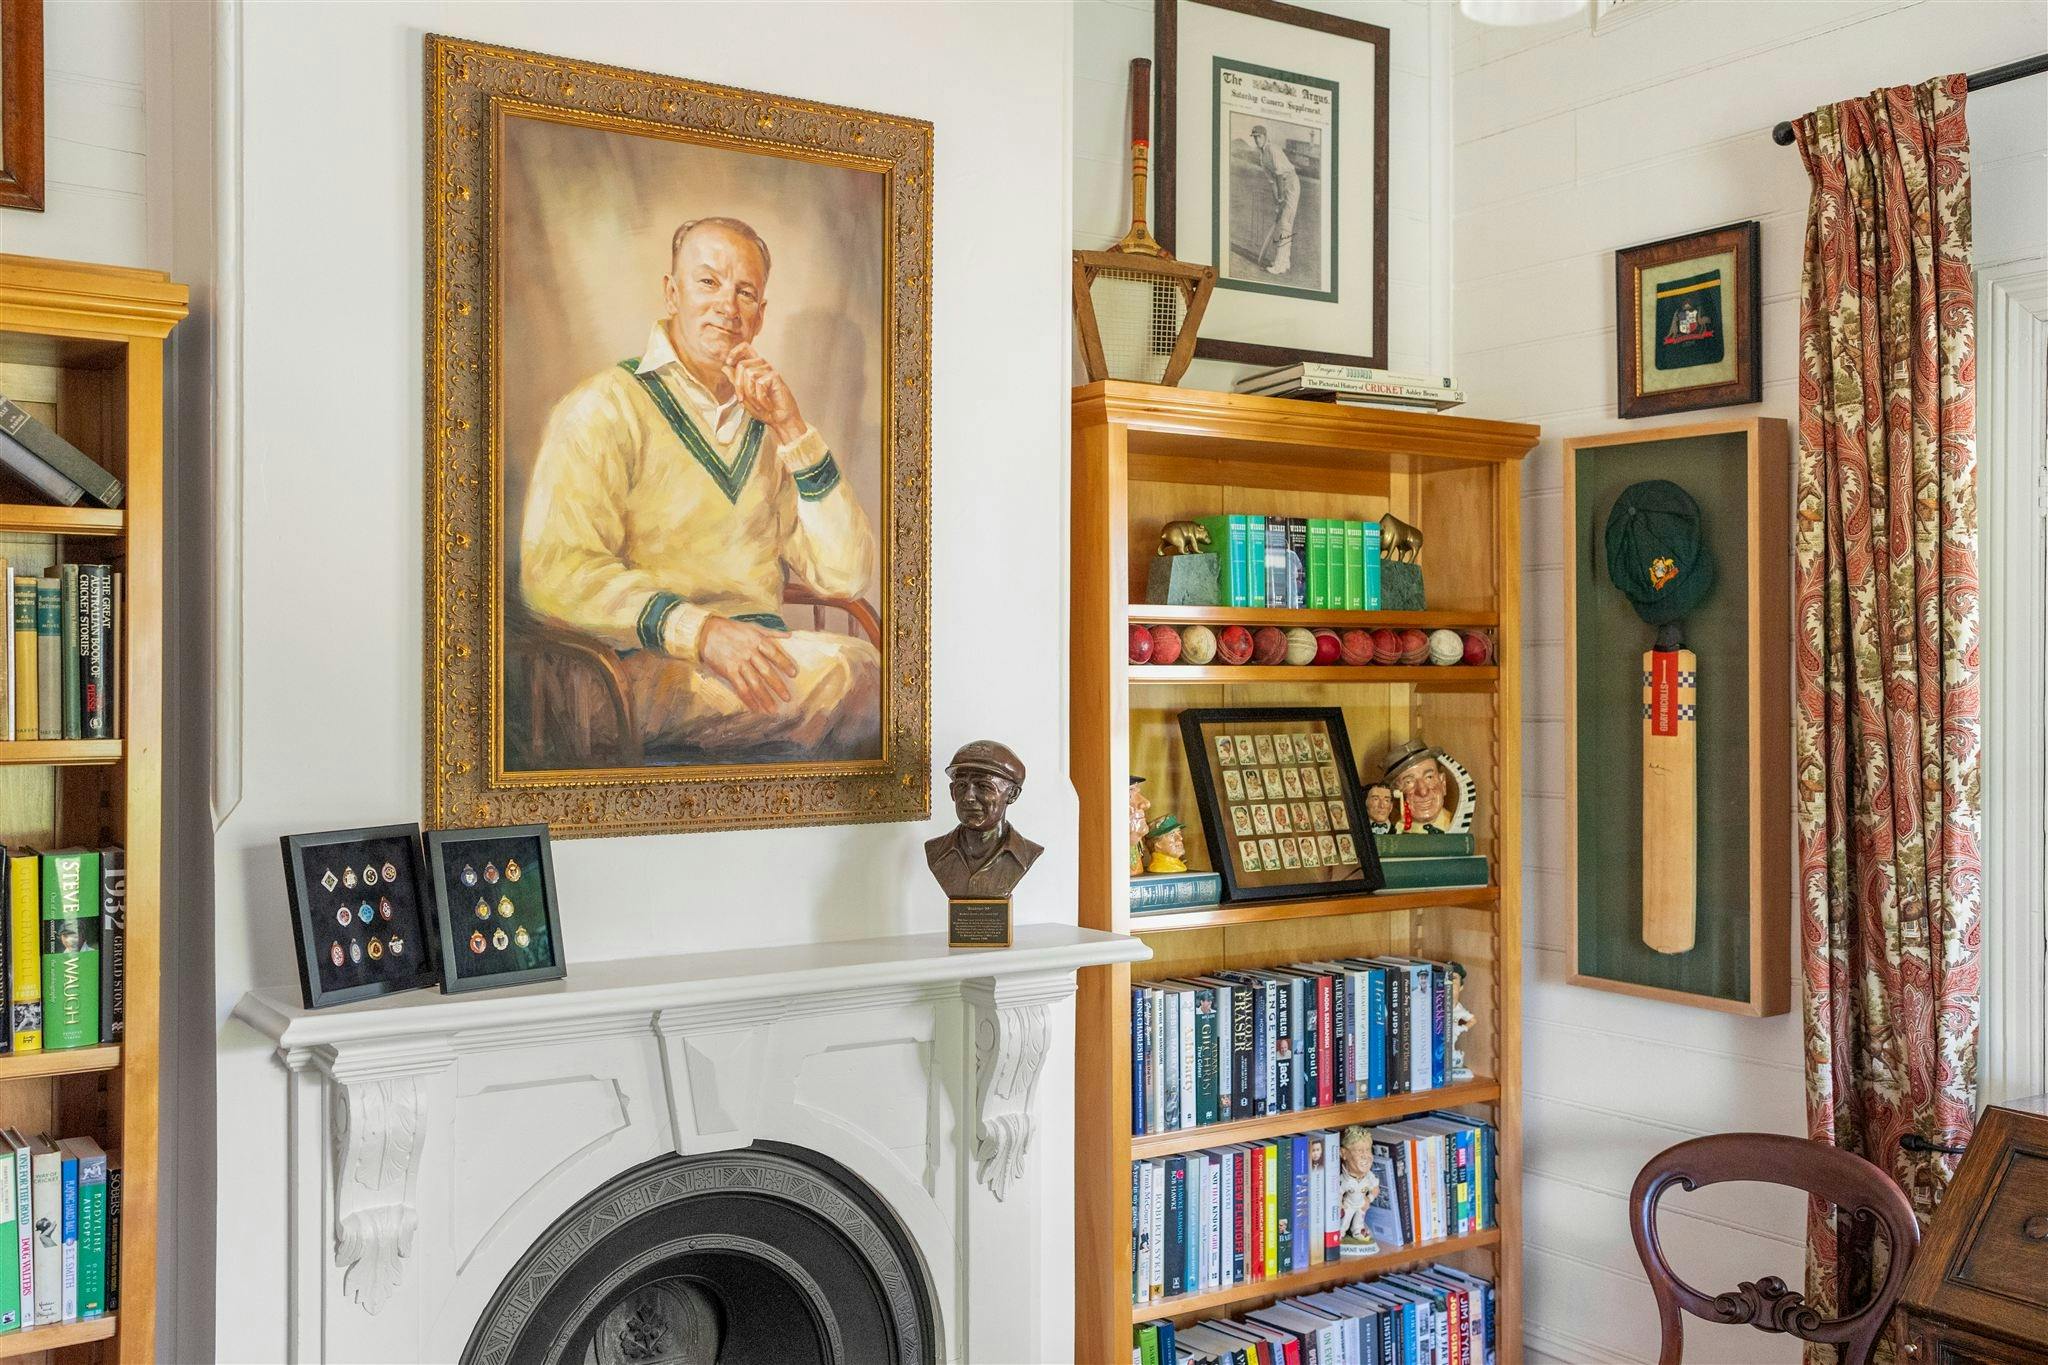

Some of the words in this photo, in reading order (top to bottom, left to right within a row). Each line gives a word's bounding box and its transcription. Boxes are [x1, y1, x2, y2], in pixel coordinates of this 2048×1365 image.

[1223, 72, 1242, 86] The
[1232, 89, 1258, 103] Saturday
[1261, 96, 1284, 107] Camera
[1336, 368, 1344, 377] of
[1341, 382, 1358, 390] History
[1365, 383, 1404, 395] CRICKET
[1406, 389, 1421, 397] Ashley
[1423, 390, 1438, 398] Brown
[80, 574, 89, 614] CRICKET
[102, 575, 110, 595] THE
[91, 574, 100, 636] AUSTRALIAN
[102, 597, 111, 628] GREAT
[80, 615, 89, 656] STORIES
[91, 637, 100, 663] BOOK
[92, 666, 100, 678] OF
[87, 684, 96, 712] PIESSE
[1660, 684, 1668, 732] GRAY-NICOLLS
[62, 861, 80, 912] STEVE
[104, 868, 124, 930] 1932
[113, 936, 122, 977] GERALD
[63, 958, 80, 1025] WAUGH
[114, 980, 123, 1014] STONE
[1280, 989, 1288, 1008] JACK
[1335, 979, 1343, 1011] LAURENCE
[1375, 980, 1384, 1025] Hazel
[1170, 1001, 1178, 1035] DEBBIE
[1234, 992, 1245, 1052] FRASER
[1244, 991, 1252, 1051] MALCOLM
[1280, 1011, 1288, 1036] WELCH
[1336, 1012, 1344, 1038] OLIVIER
[1435, 989, 1445, 1034] Reckless
[1185, 1026, 1193, 1052] Ash
[1183, 1056, 1194, 1093] Barty
[1202, 1024, 1211, 1097] GILCHRIST
[1278, 1062, 1289, 1087] jack
[1308, 1047, 1317, 1076] gould
[19, 1154, 28, 1169] ONE
[20, 1170, 28, 1184] FOR
[1235, 1157, 1243, 1200] ANDREW
[20, 1184, 28, 1203] THE
[111, 1174, 120, 1215] SOBERS
[21, 1204, 29, 1225] ROAD
[83, 1199, 91, 1250] AUTOPSY
[93, 1193, 102, 1252] BODYLINE
[1235, 1204, 1243, 1254] FLINTOFF
[22, 1238, 30, 1259] DOUG
[22, 1261, 32, 1296] WALTERS
[1324, 1332, 1332, 1345] ON
[1461, 1321, 1470, 1365] STYNE
